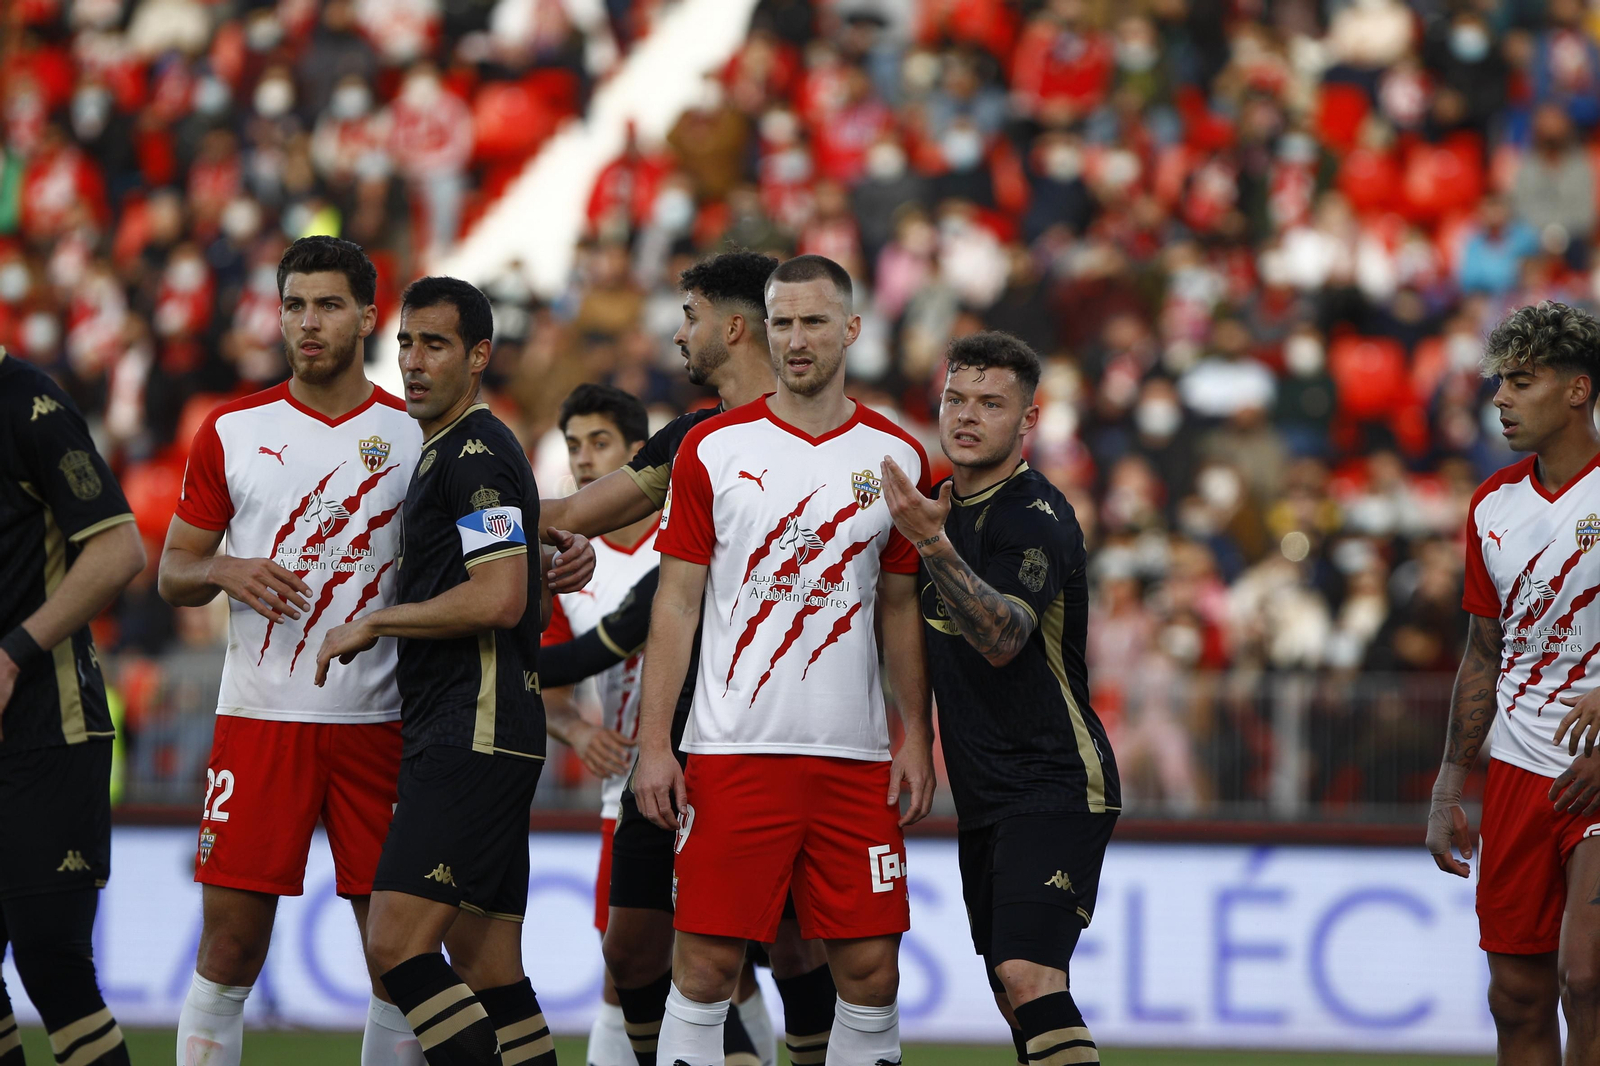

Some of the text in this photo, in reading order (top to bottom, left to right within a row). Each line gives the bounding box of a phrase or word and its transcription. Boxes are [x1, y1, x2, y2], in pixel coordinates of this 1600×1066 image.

[279, 559, 376, 573] Arabian Centres
[749, 587, 848, 609] Arabian Centres
[1541, 640, 1582, 653] Centres
[673, 803, 696, 855] 9
